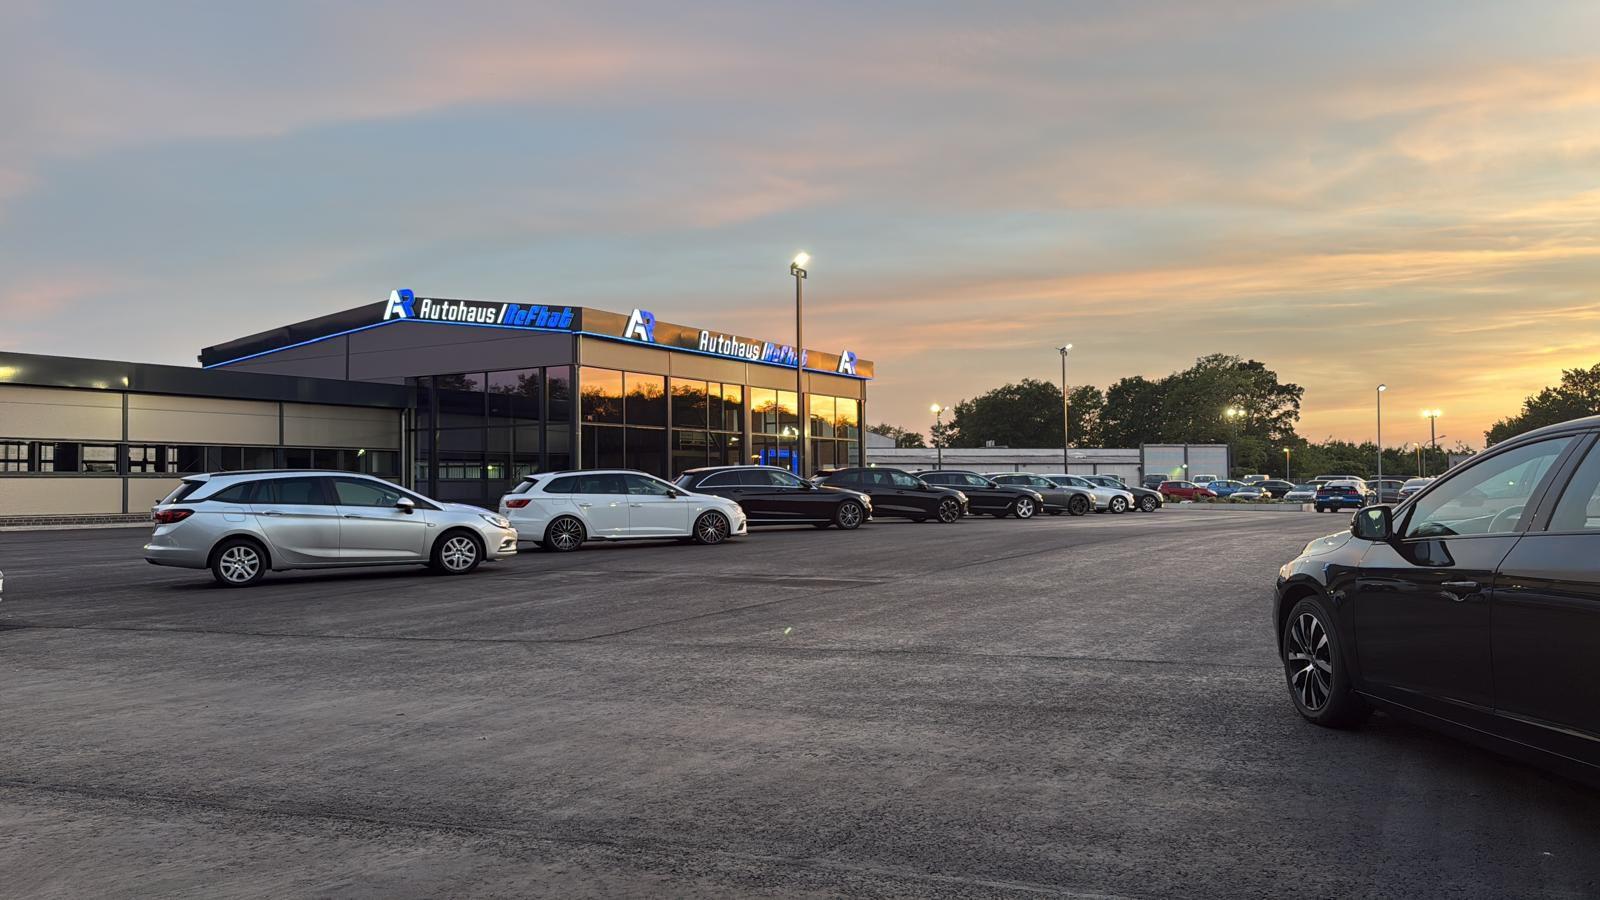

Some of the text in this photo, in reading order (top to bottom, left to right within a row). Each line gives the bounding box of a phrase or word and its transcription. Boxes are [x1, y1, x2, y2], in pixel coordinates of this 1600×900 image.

[383, 288, 415, 320] AR
[420, 299, 496, 323] Autohaus
[625, 308, 656, 342] AR
[699, 331, 760, 360] Autohaus
[839, 350, 858, 374] AR
